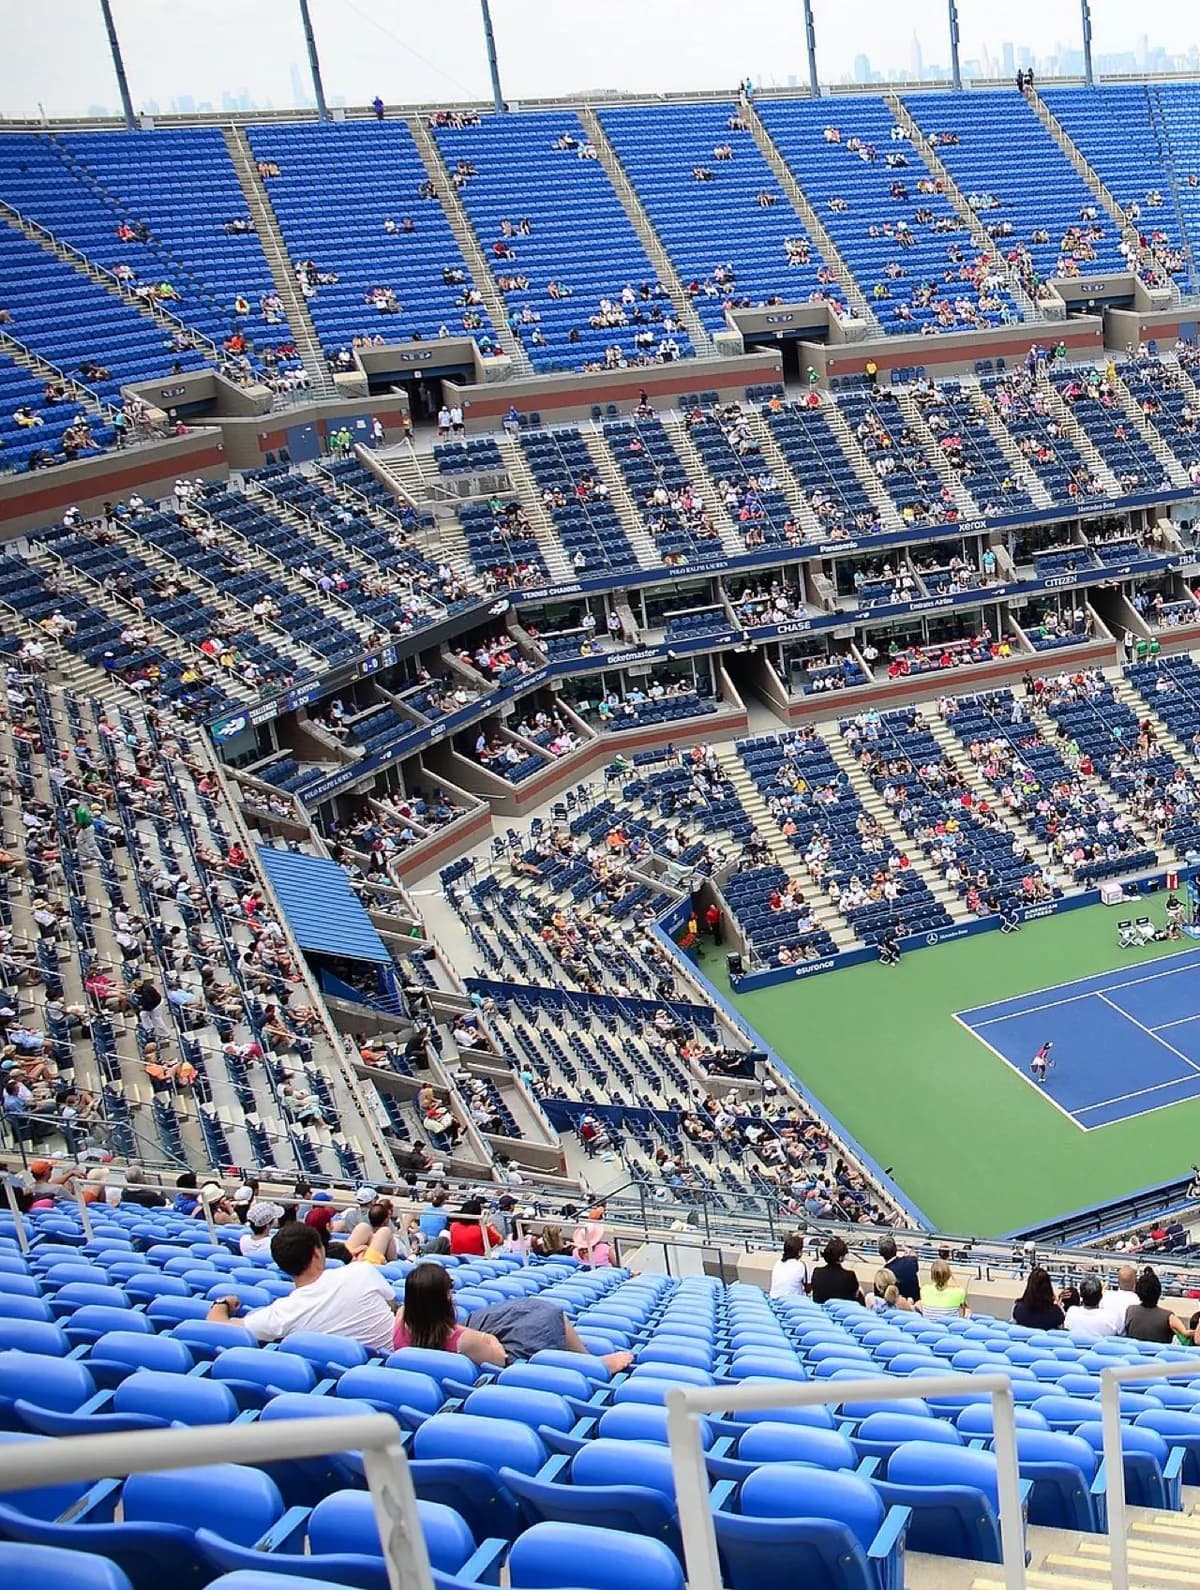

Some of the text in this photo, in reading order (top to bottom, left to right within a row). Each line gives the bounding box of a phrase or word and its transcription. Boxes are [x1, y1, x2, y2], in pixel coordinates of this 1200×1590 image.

[958, 520, 987, 532] xerox
[1179, 554, 1197, 566] IBM
[1044, 574, 1078, 588] CITIZEN
[522, 584, 583, 600] TENNIS CHANNEL
[777, 620, 812, 634] CHASE
[607, 649, 659, 664] ticketmaster
[1024, 903, 1058, 916] AMERICAN
[796, 960, 836, 976] esurance
